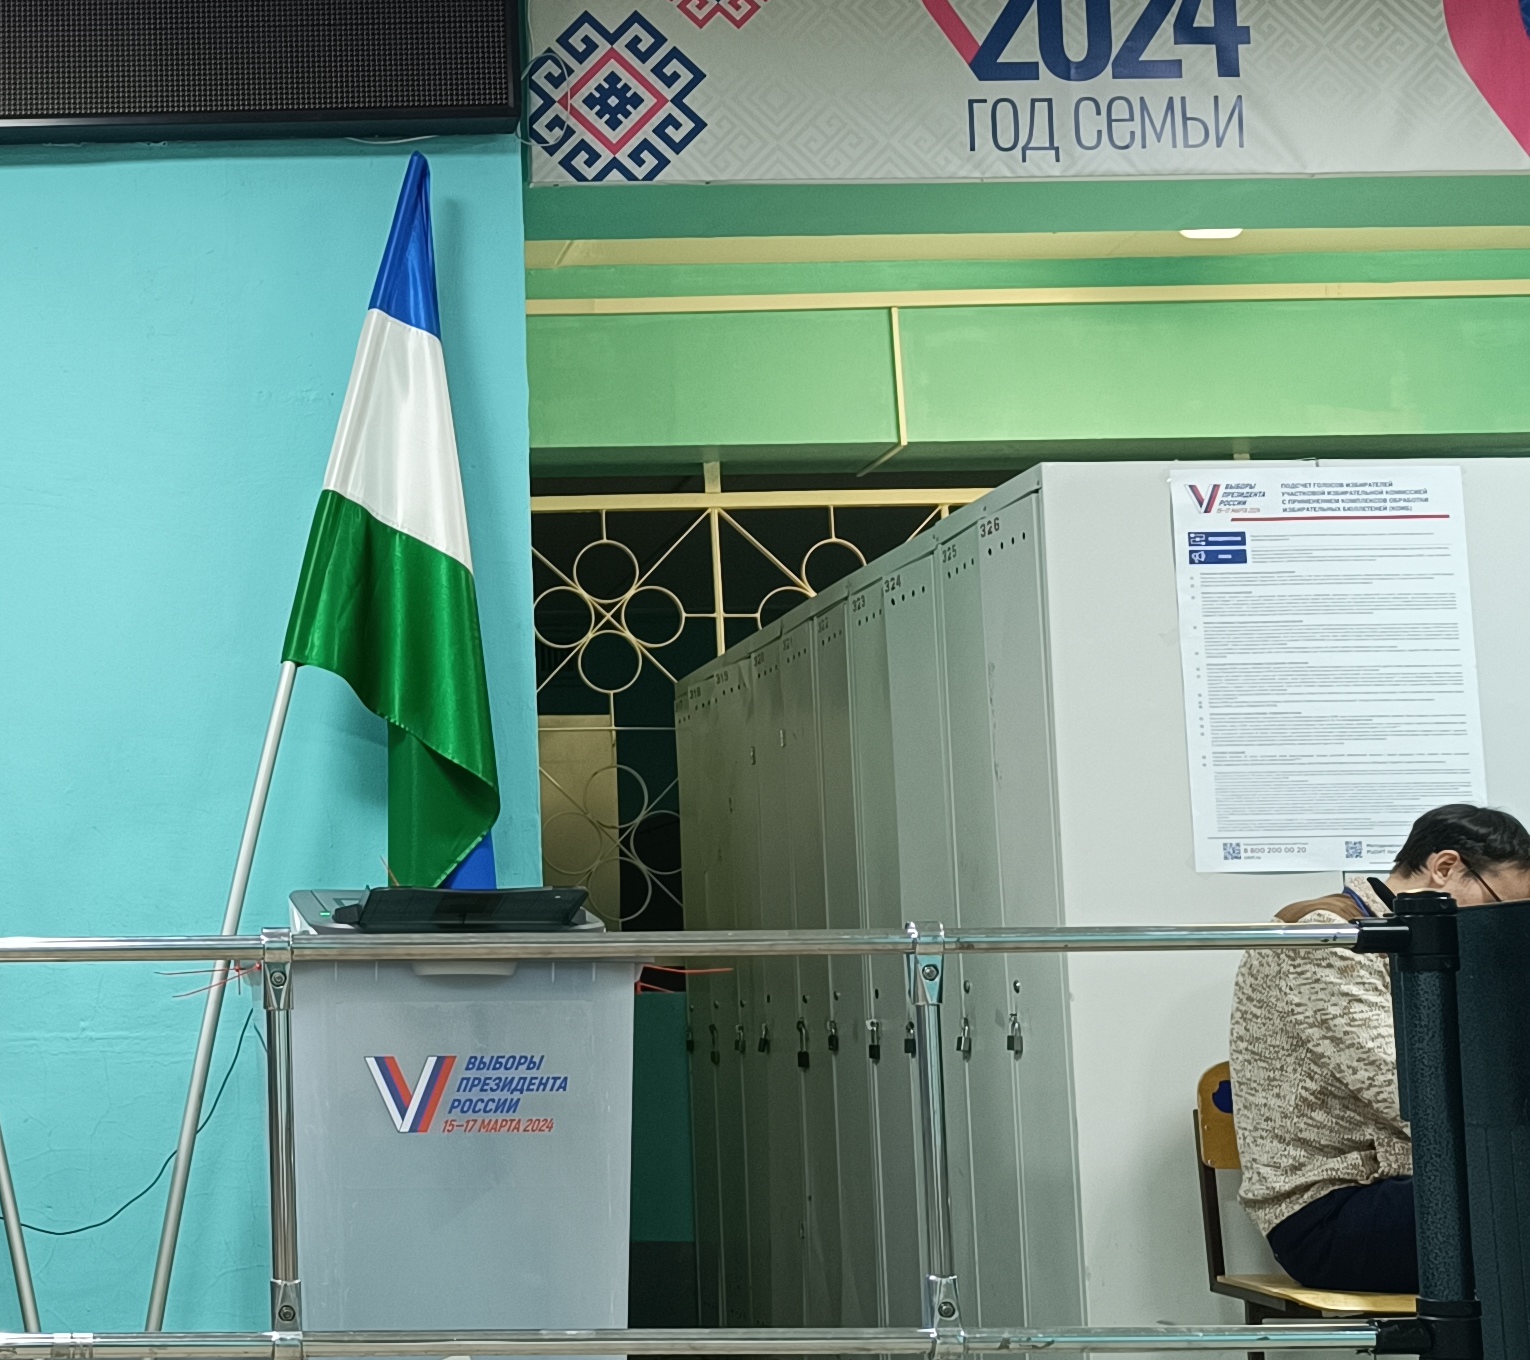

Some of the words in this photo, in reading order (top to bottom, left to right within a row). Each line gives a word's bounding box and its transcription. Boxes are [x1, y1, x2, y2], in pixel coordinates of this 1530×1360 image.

[1281, 489, 1325, 497] УЧАСТКОВОЙ
[979, 517, 1000, 538] 326
[942, 544, 957, 563] 325
[884, 574, 902, 593] 324
[851, 594, 866, 613] 323
[464, 1055, 546, 1071] ВЫБОРЫ
[456, 1076, 569, 1095] ПРЕЗИДЕНТА
[447, 1098, 521, 1114] РОССИИ
[478, 1119, 521, 1132] МАРТА
[523, 1118, 555, 1132] 2024
